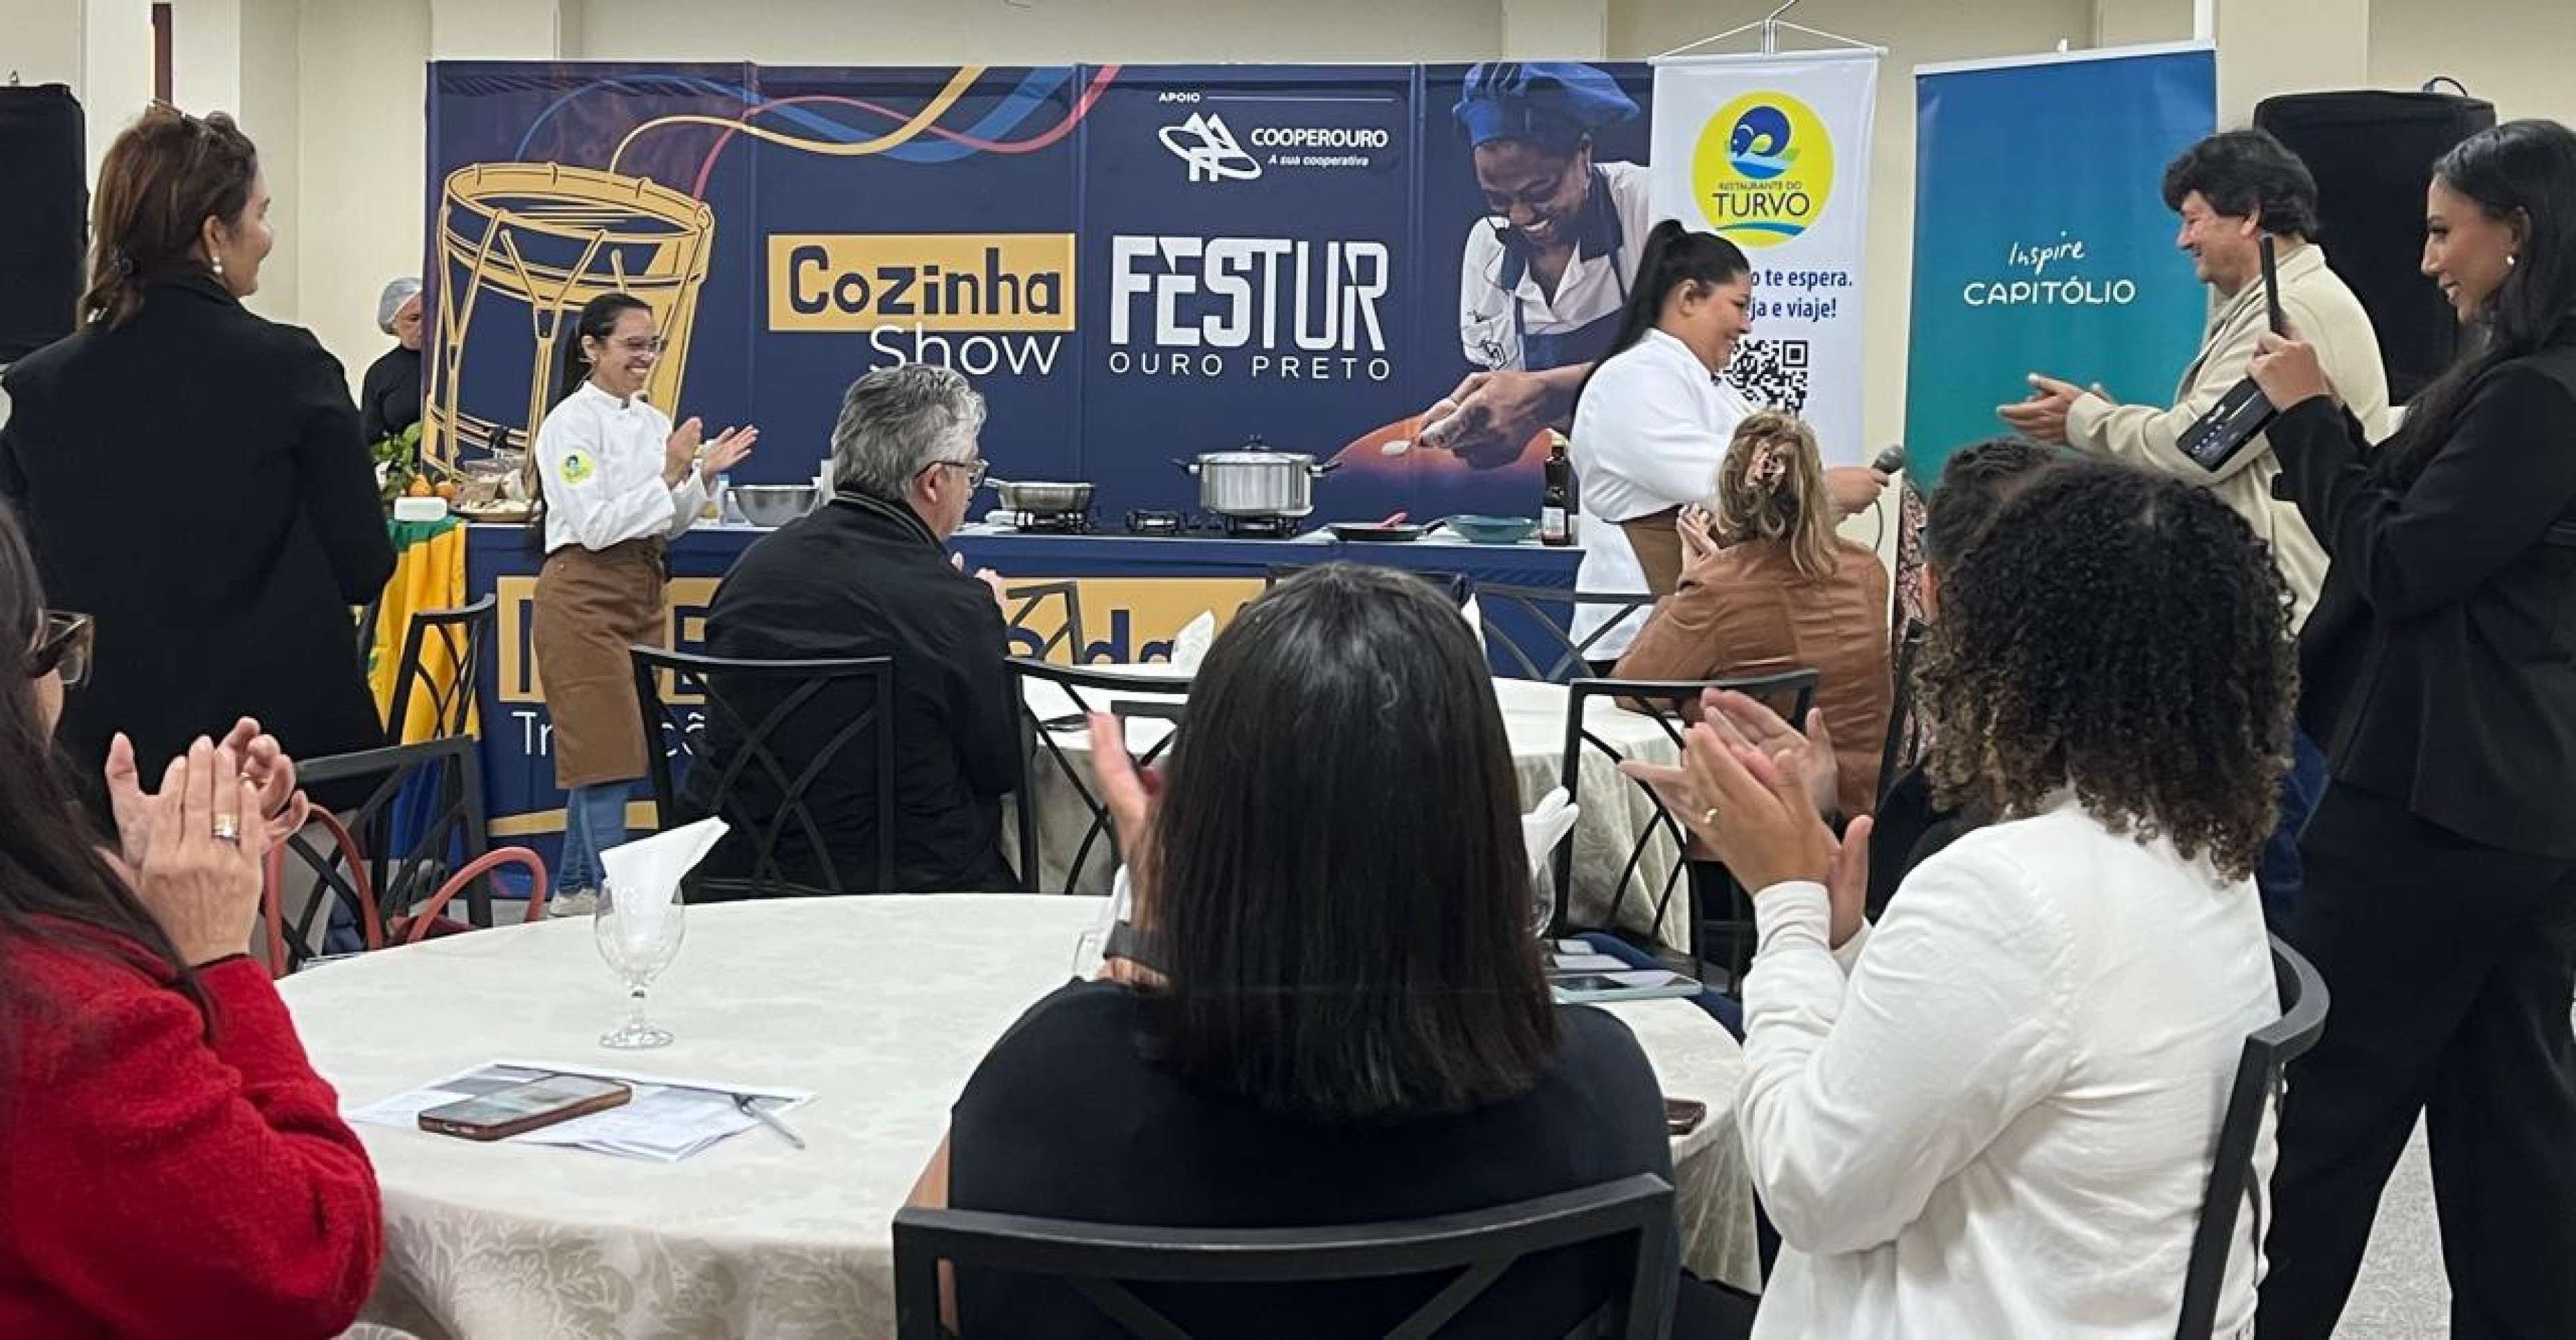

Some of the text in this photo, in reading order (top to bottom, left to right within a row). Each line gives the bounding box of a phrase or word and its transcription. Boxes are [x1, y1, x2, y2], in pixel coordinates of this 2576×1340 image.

[1158, 92, 1201, 103] APOIO
[1251, 128, 1390, 148] COOPEROURO
[1267, 154, 1369, 168] A sua cooperativa
[1718, 180, 1802, 190] RESTAURANTE DO
[1712, 192, 1810, 218] TURVO
[2008, 229, 2085, 275] Inspire
[788, 244, 1062, 316] Cozinha
[1110, 234, 1390, 352] FESTUR
[1765, 269, 1784, 286] te
[1788, 270, 1853, 292] espera.
[1963, 276, 2137, 306] CAPITÓLIO
[1772, 301, 1782, 316] e
[1786, 297, 1837, 322] viaje!
[869, 321, 1062, 376] Show
[1109, 351, 1391, 381] OURO PRETO
